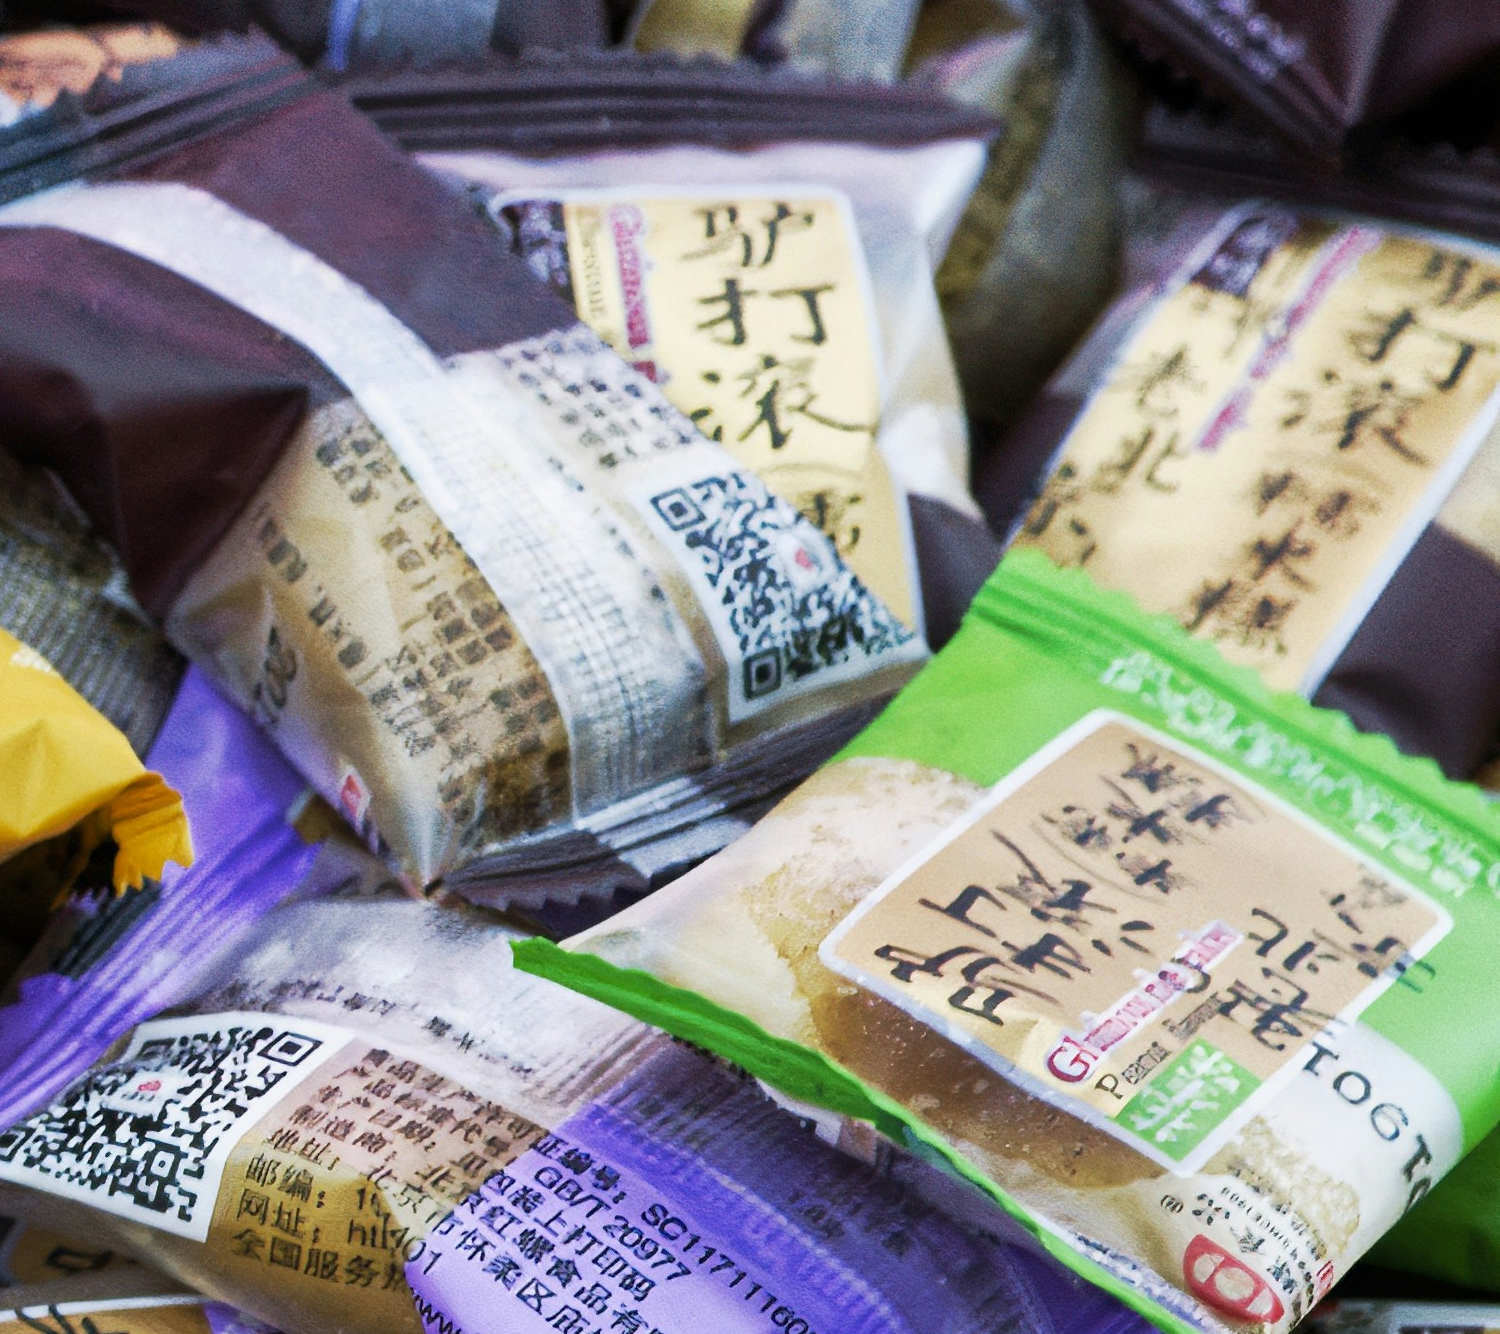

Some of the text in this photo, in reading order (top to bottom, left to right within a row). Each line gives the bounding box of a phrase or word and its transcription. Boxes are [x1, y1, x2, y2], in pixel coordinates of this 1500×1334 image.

[677, 199, 879, 451] 驴打滚
[602, 1215, 693, 1283] 20977
